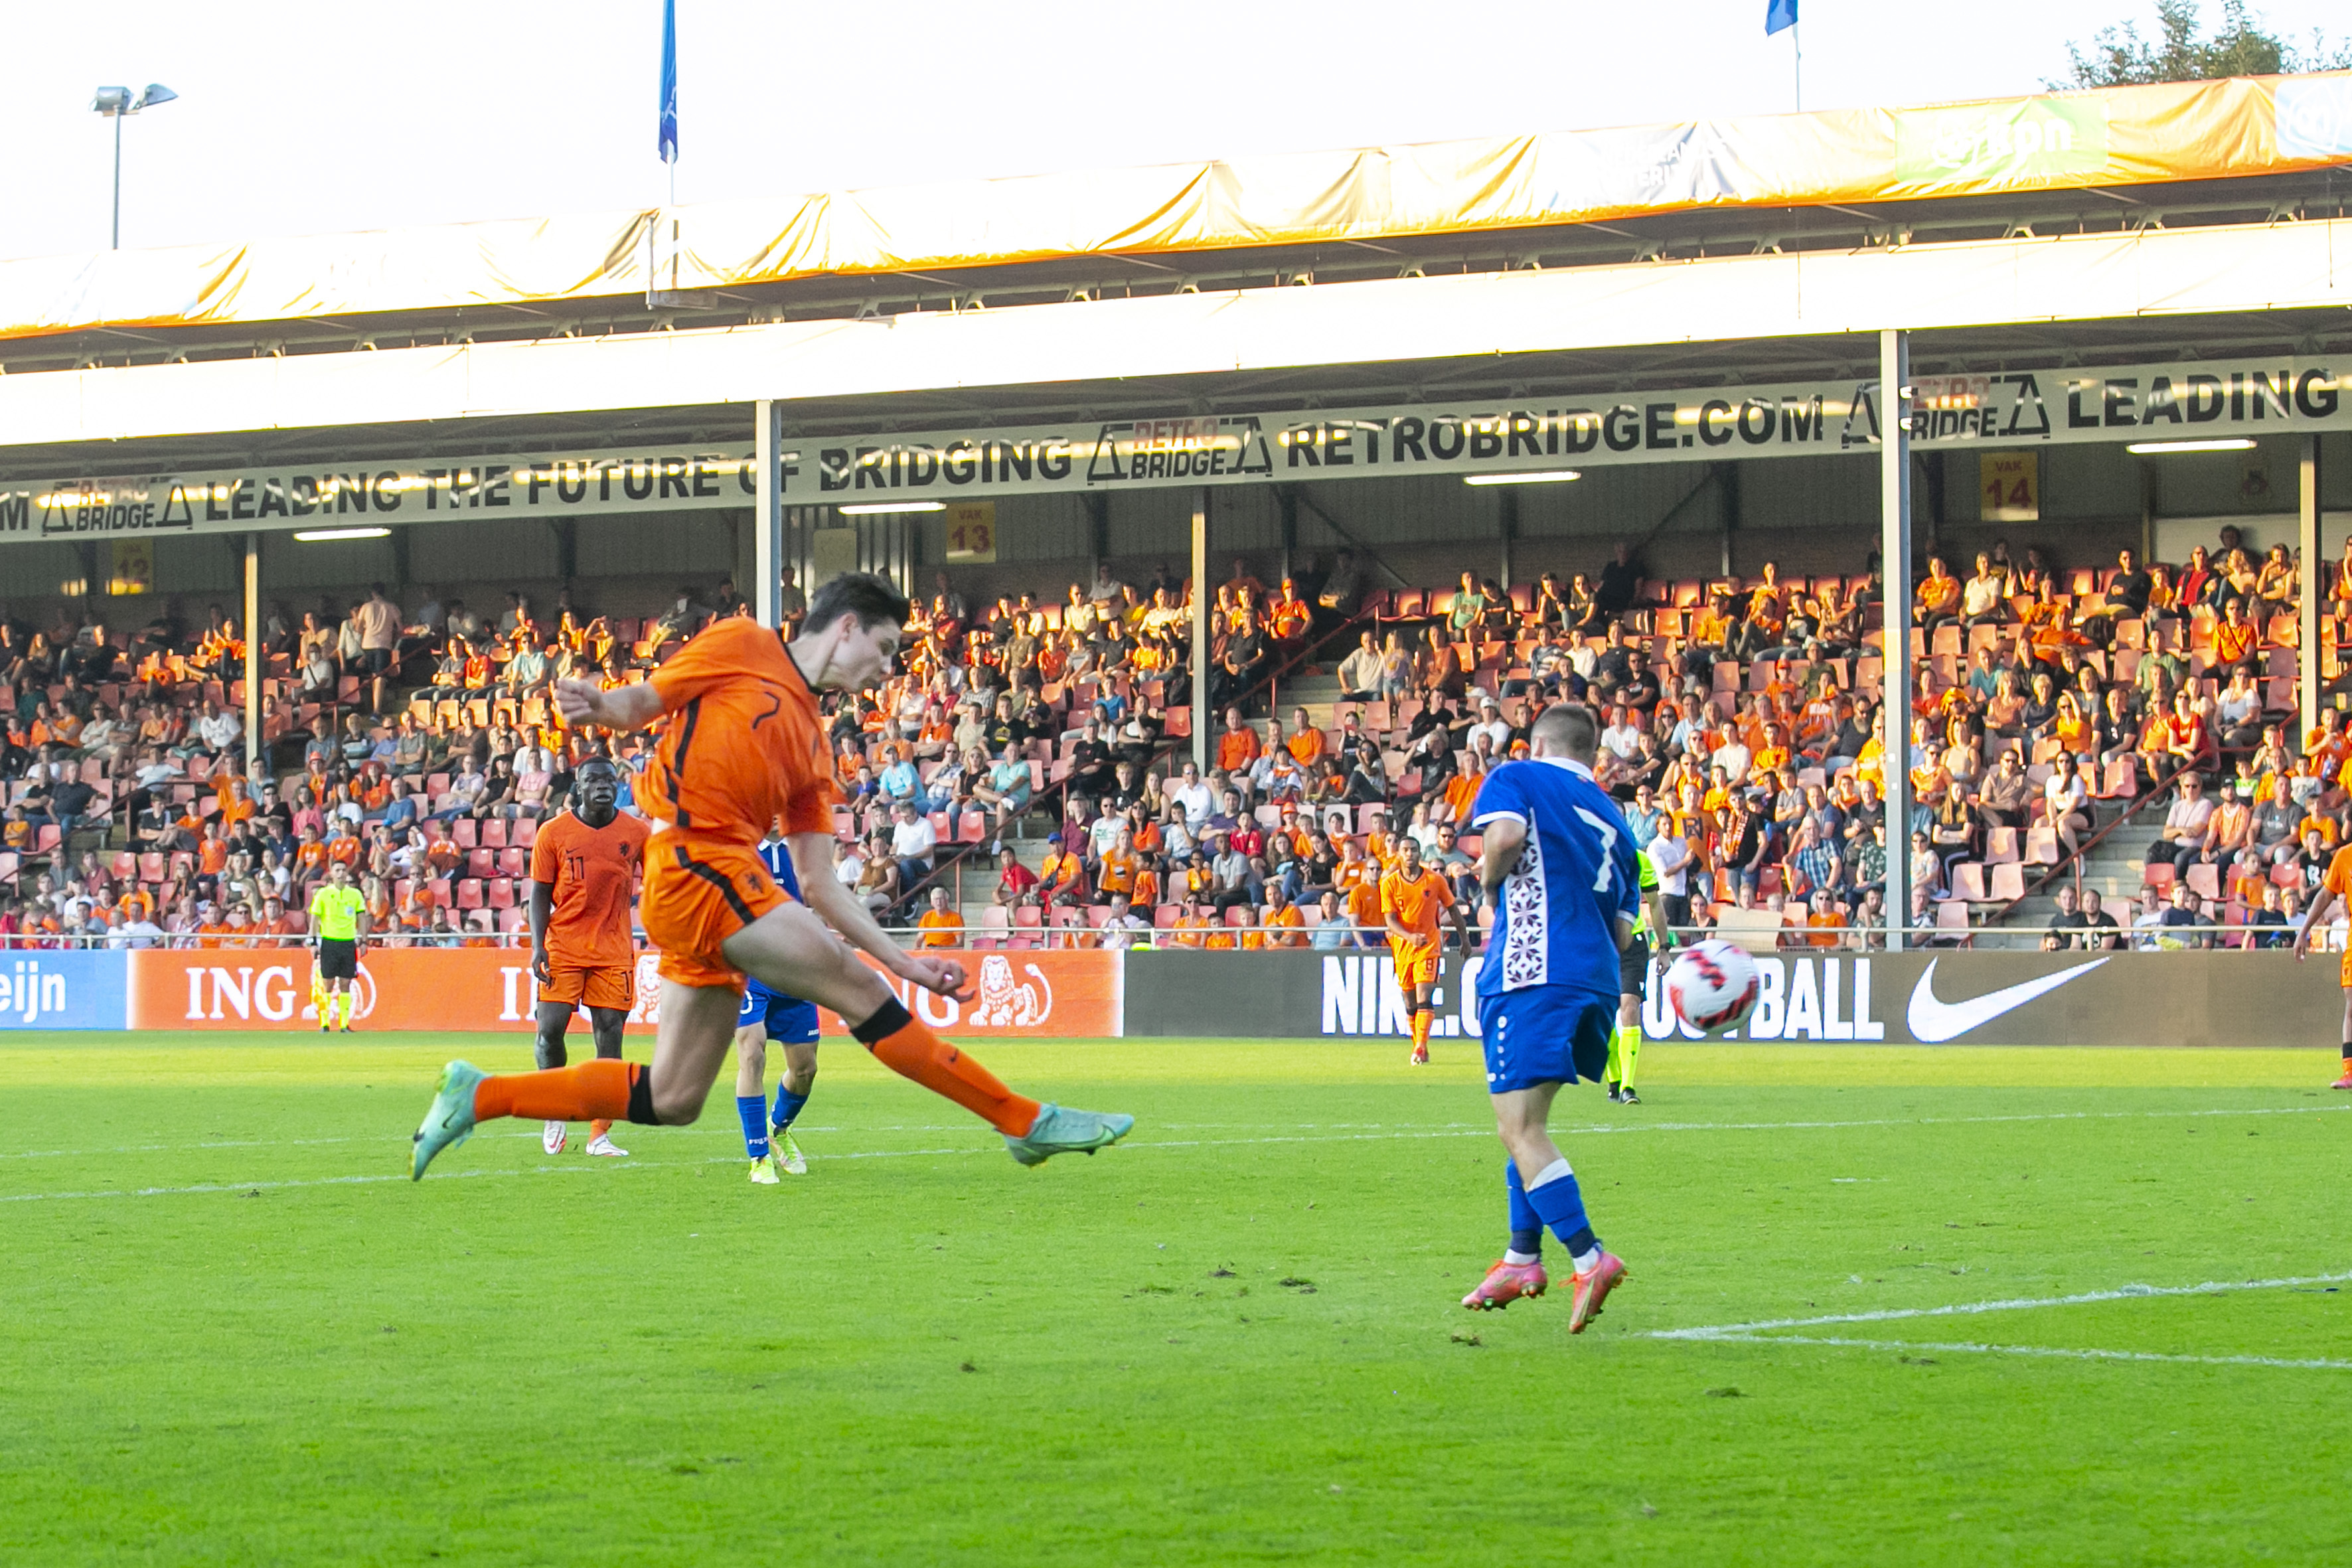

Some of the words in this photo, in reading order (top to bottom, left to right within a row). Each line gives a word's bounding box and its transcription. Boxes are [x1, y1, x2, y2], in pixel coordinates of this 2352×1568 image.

[1986, 114, 2072, 166] kpn
[1912, 376, 1990, 410] ETRO
[2068, 368, 2339, 429] LEADING
[1134, 418, 1218, 449] RETRO
[1287, 394, 1823, 467] RETROBRIDGE.COM
[1910, 407, 1998, 440] RIDGE
[206, 470, 402, 521] LEADING
[418, 465, 510, 509] THE
[529, 455, 720, 505] FUTURE
[821, 435, 1071, 491] BRIDGING
[1131, 447, 1227, 479] BRIDGE
[1986, 478, 2032, 510] 14
[76, 503, 155, 531] BRIDGE
[951, 524, 990, 554] 13
[1571, 804, 1618, 893] 7
[568, 856, 584, 880] 11
[185, 965, 297, 1021] ING
